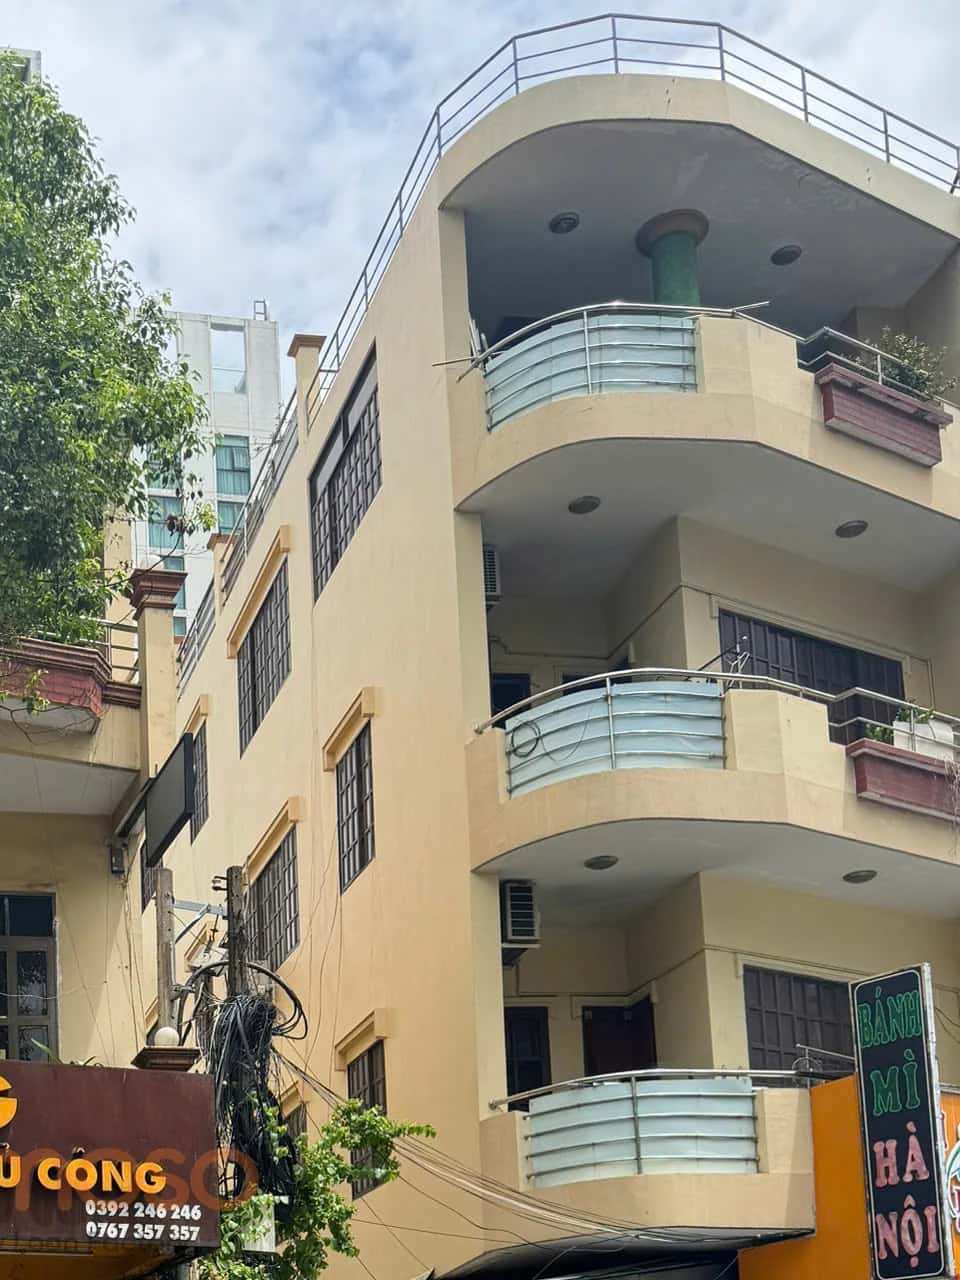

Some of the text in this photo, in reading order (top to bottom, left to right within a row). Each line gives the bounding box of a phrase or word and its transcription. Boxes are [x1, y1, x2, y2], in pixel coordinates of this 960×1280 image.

[858, 986, 922, 1048] BÁNH
[870, 1049, 920, 1116] MÌ
[38, 1146, 166, 1194] CÔNG
[873, 1121, 929, 1188] HÀ
[85, 1200, 202, 1220] 0392 246 246
[85, 1221, 200, 1241] 0767 357 357
[875, 1194, 939, 1268] NỘI
